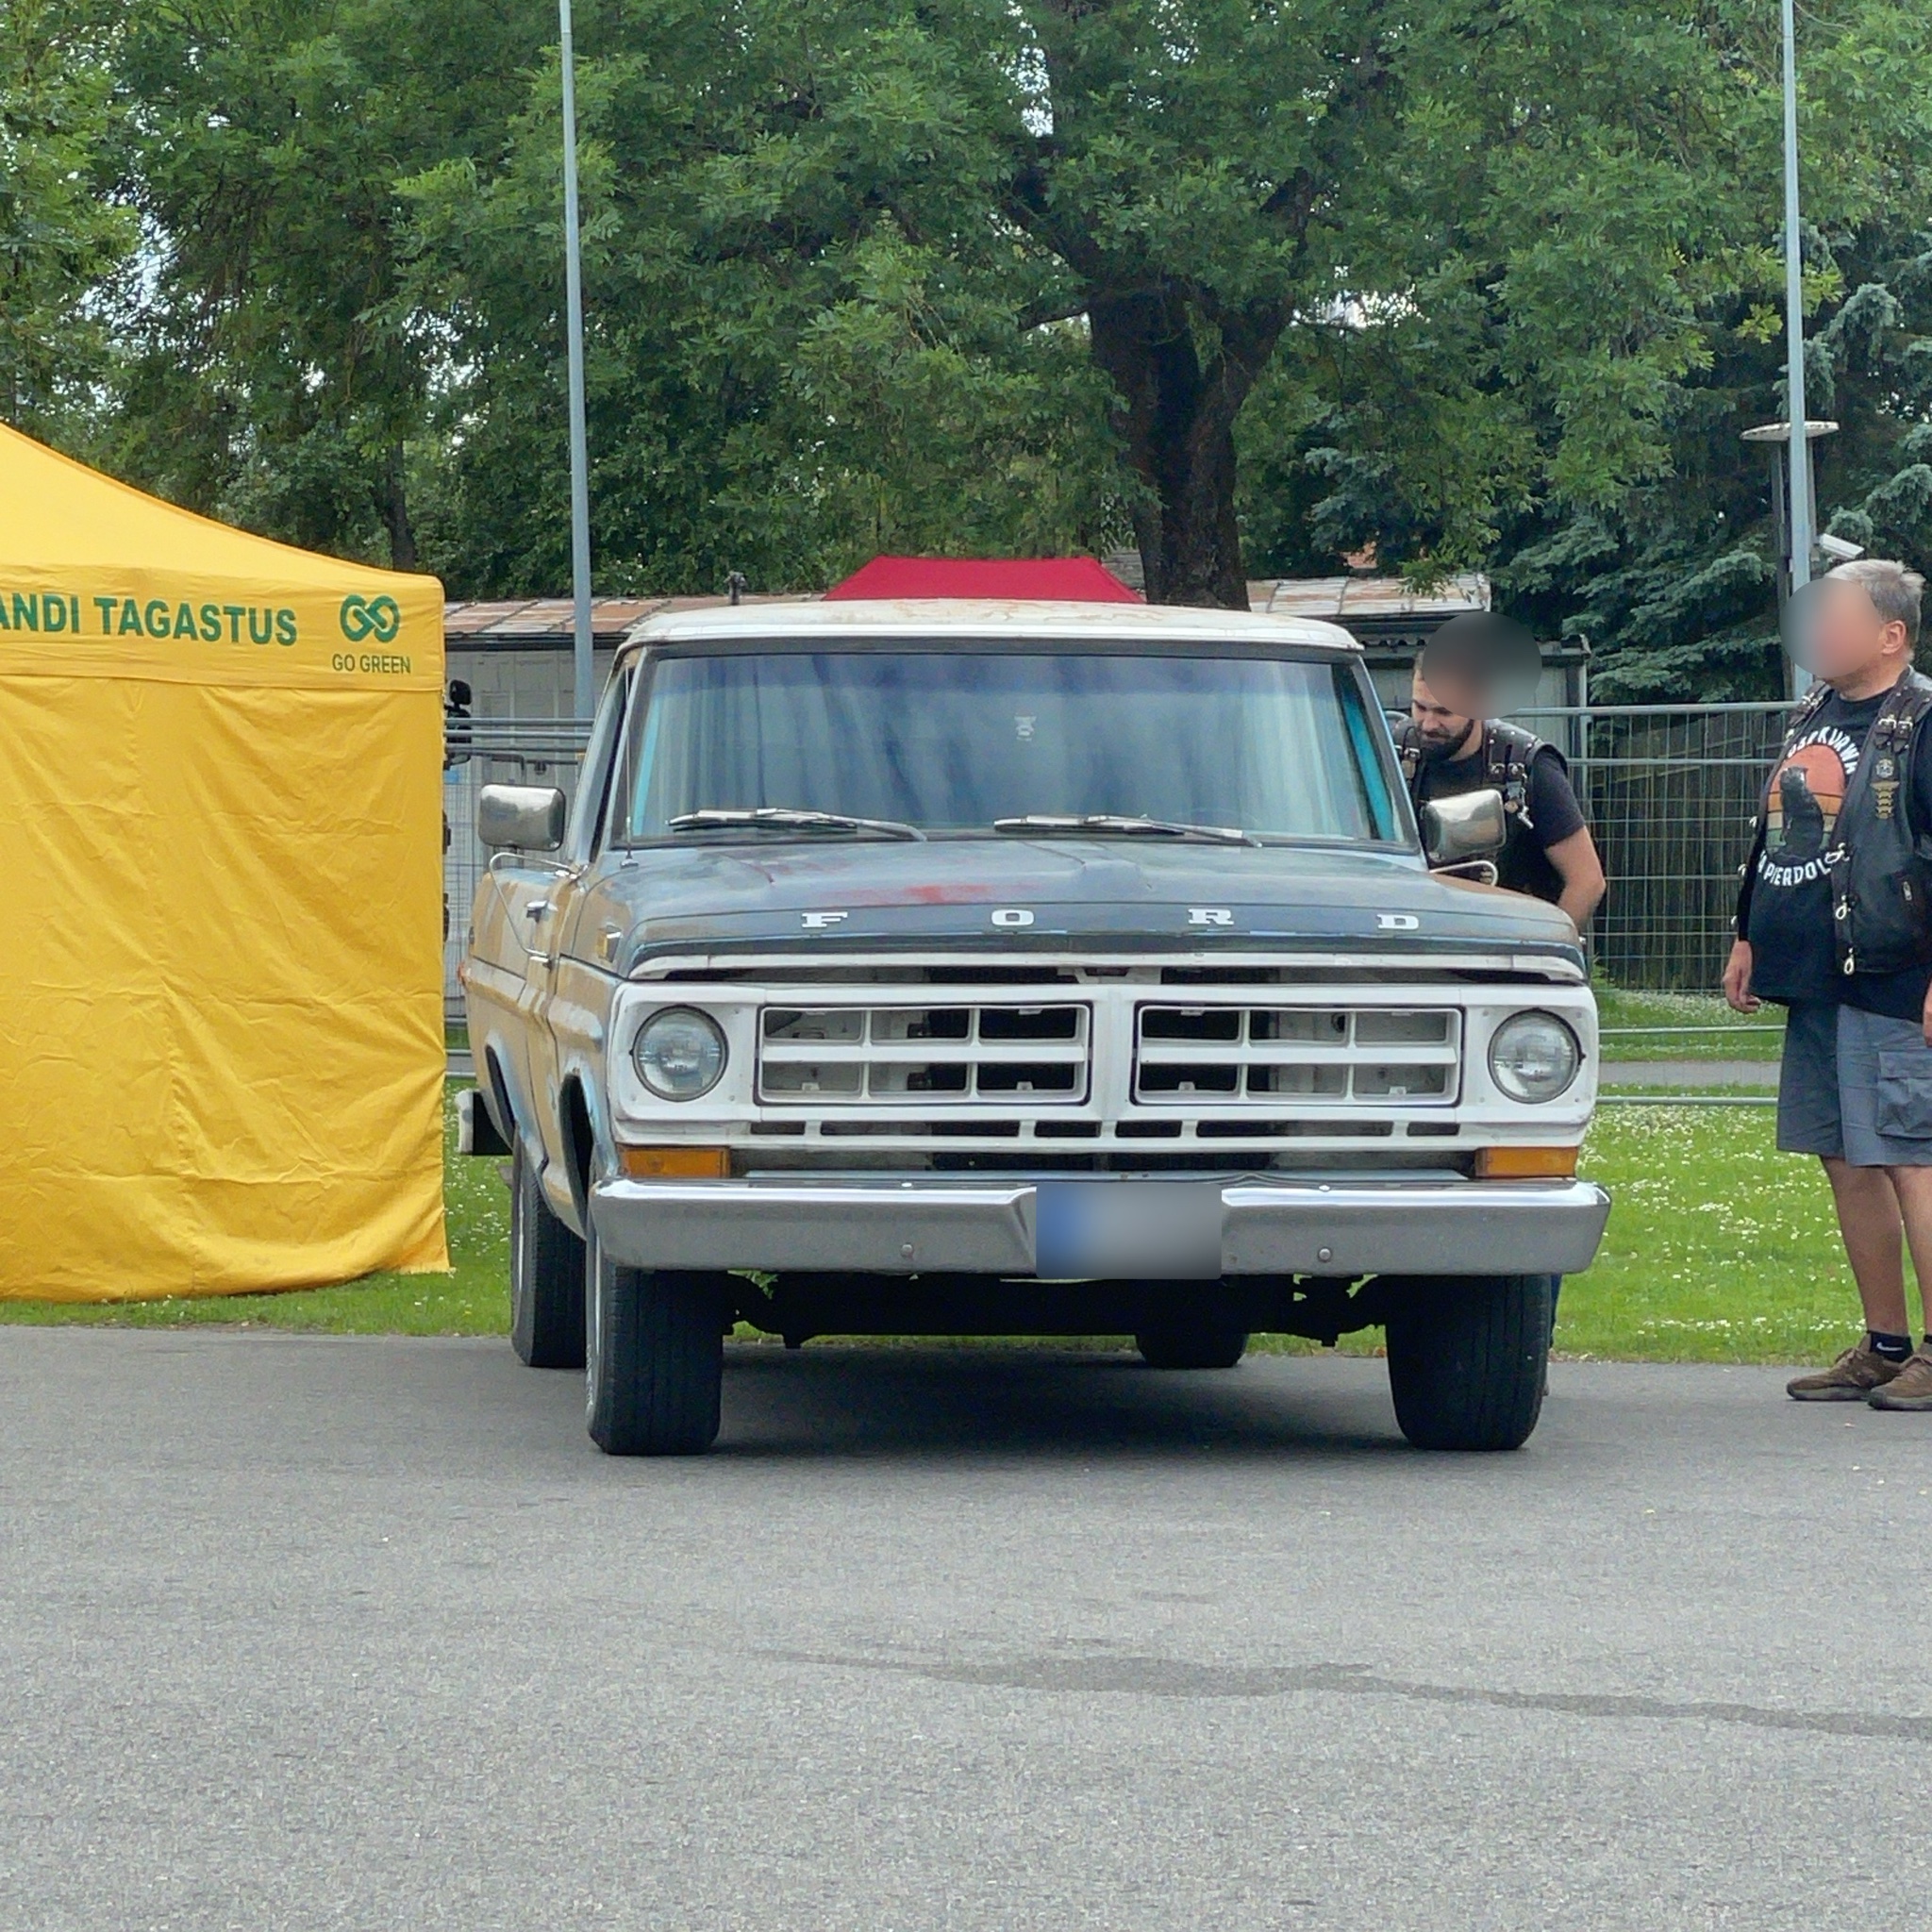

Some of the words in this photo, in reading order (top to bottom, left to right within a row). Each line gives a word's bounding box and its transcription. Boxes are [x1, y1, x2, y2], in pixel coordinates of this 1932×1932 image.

[94, 597, 297, 645] TAGASTUS
[332, 653, 356, 672] GO
[359, 655, 411, 674] GREEN
[1763, 858, 1832, 887] PIERDOL
[802, 908, 1419, 930] FORD
